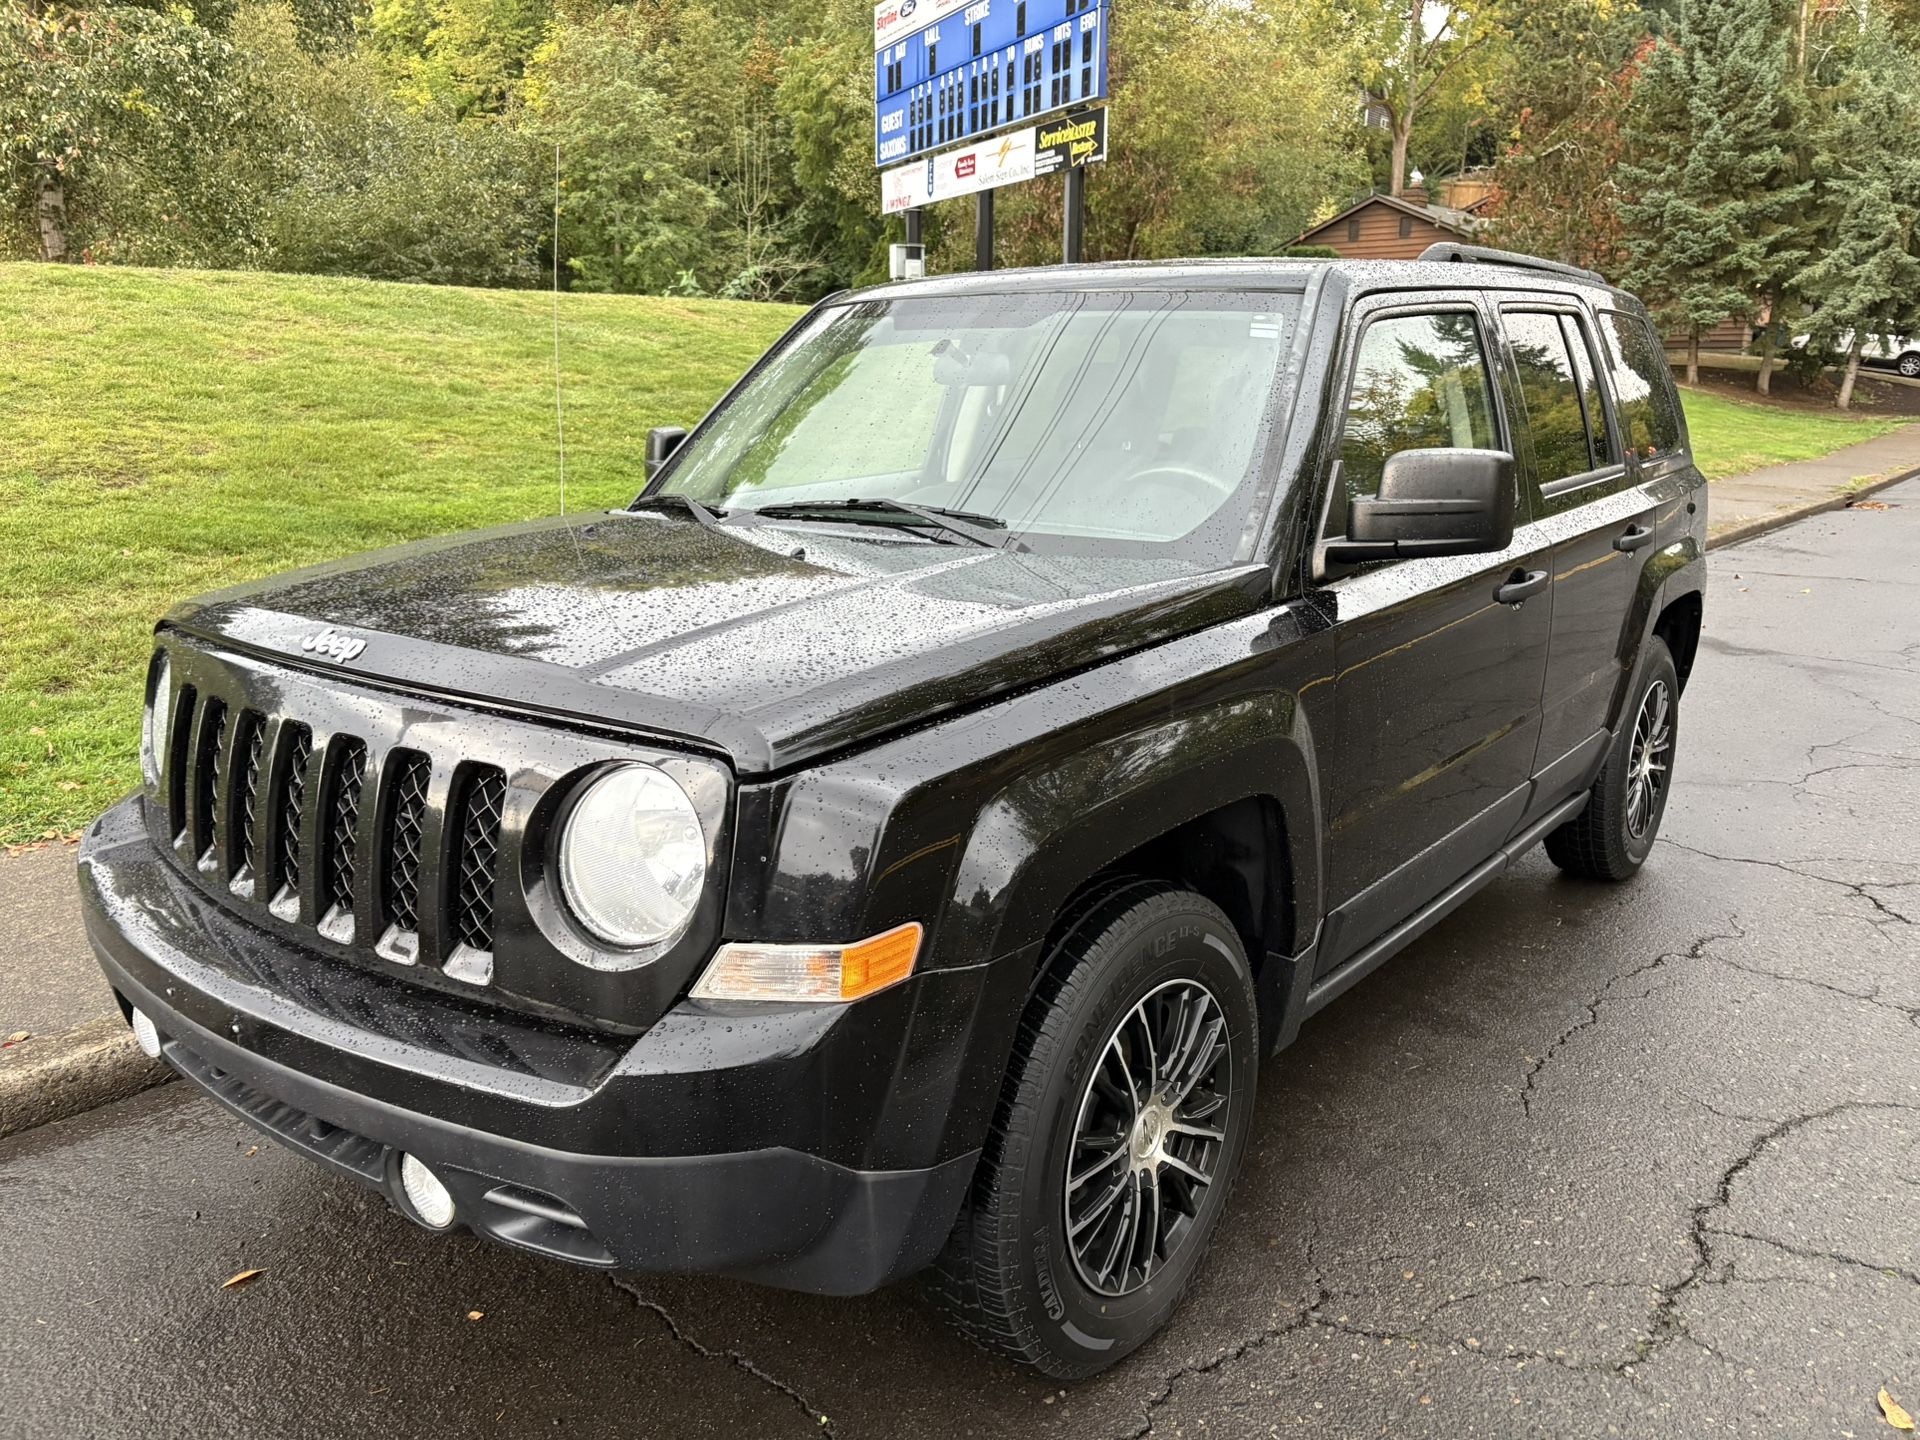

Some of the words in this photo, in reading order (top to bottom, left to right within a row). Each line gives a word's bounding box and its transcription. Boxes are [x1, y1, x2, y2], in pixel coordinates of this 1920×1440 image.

[964, 1, 990, 26] STRIKE
[924, 25, 940, 47] BALL
[883, 49, 891, 66] AT
[895, 41, 907, 60] BAT
[911, 88, 915, 100] 1
[918, 84, 923, 98] 2
[927, 80, 932, 94] 3
[940, 75, 945, 89] 4
[948, 71, 953, 86] 5
[958, 67, 963, 81] 6
[972, 61, 977, 76] 7
[982, 56, 988, 72] 8
[992, 52, 998, 67] 9
[1006, 45, 1015, 62] 10
[1024, 33, 1044, 55] RUNS
[1053, 21, 1072, 42] HITS
[1080, 11, 1097, 33] ERR
[881, 109, 904, 134] GUEST
[879, 135, 906, 160] SAXONS
[978, 173, 994, 186] Salem
[301, 627, 367, 664] Jeep
